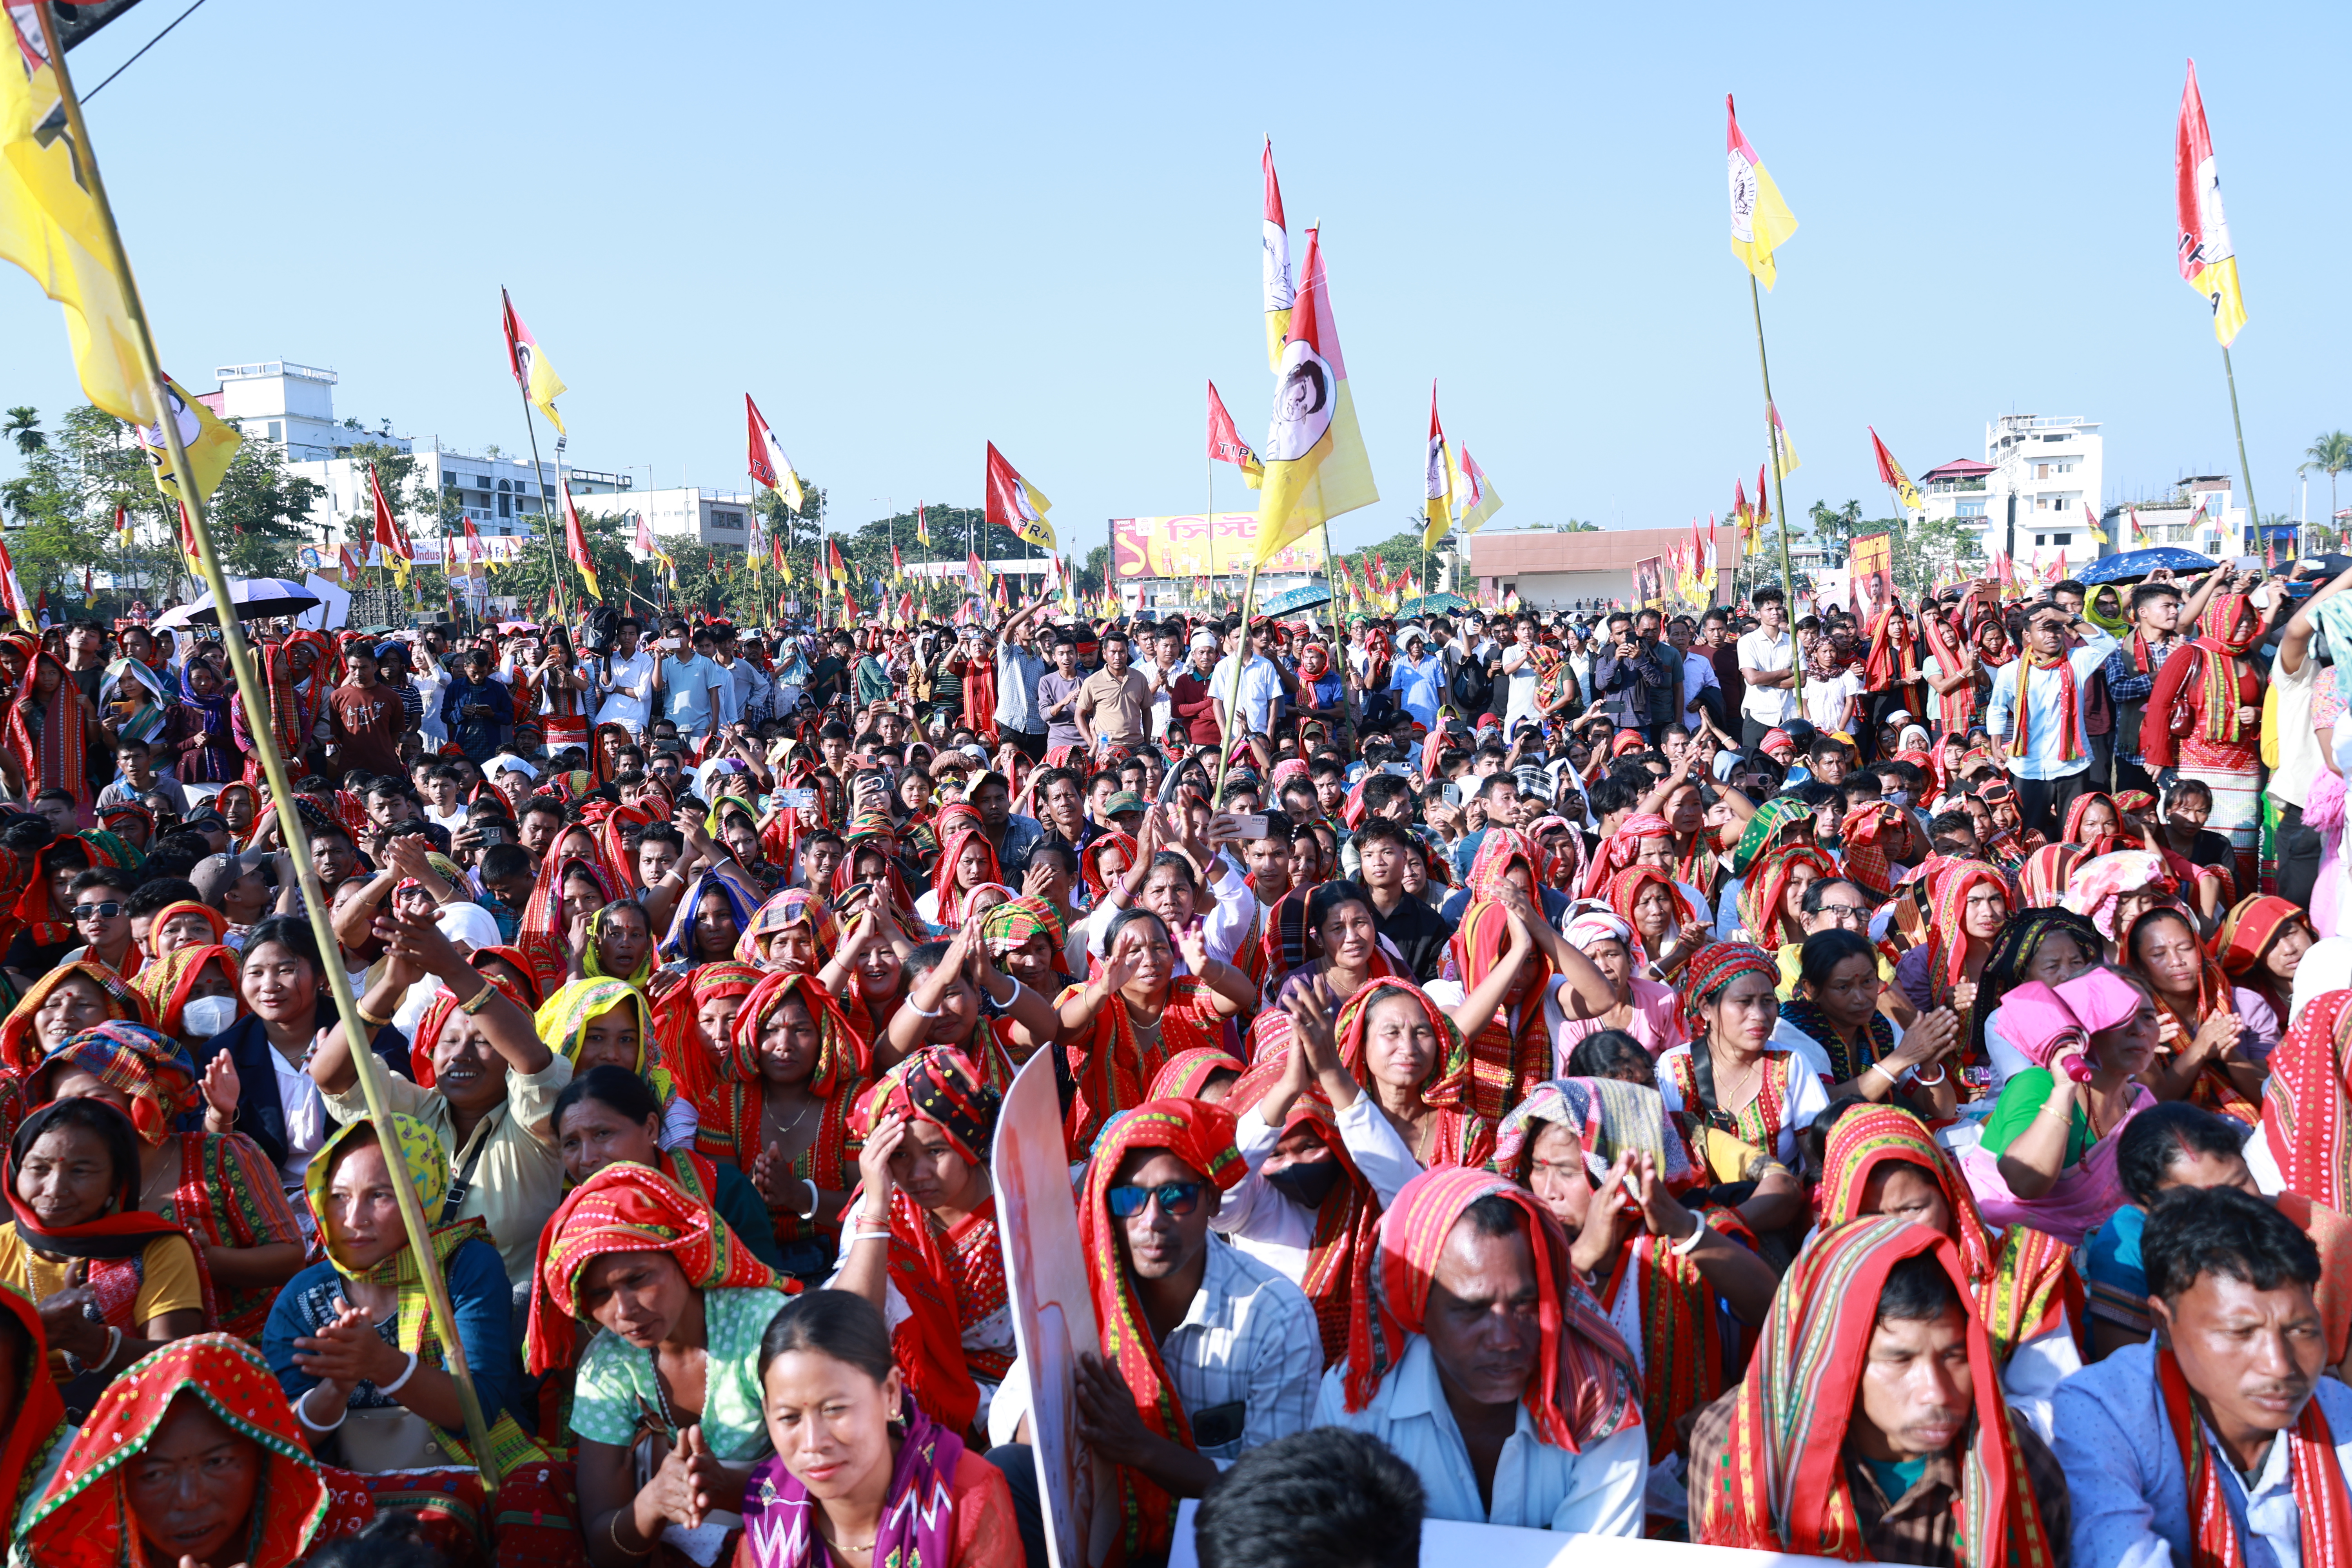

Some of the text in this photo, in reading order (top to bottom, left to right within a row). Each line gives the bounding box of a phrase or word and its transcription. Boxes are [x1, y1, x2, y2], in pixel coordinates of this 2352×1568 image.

[1218, 442, 1265, 468] TIPR
[1003, 507, 1051, 543] TIPRA
[416, 541, 447, 549] NORTHEAT
[416, 550, 446, 561] Indus
[1873, 552, 1889, 572] LIVE
